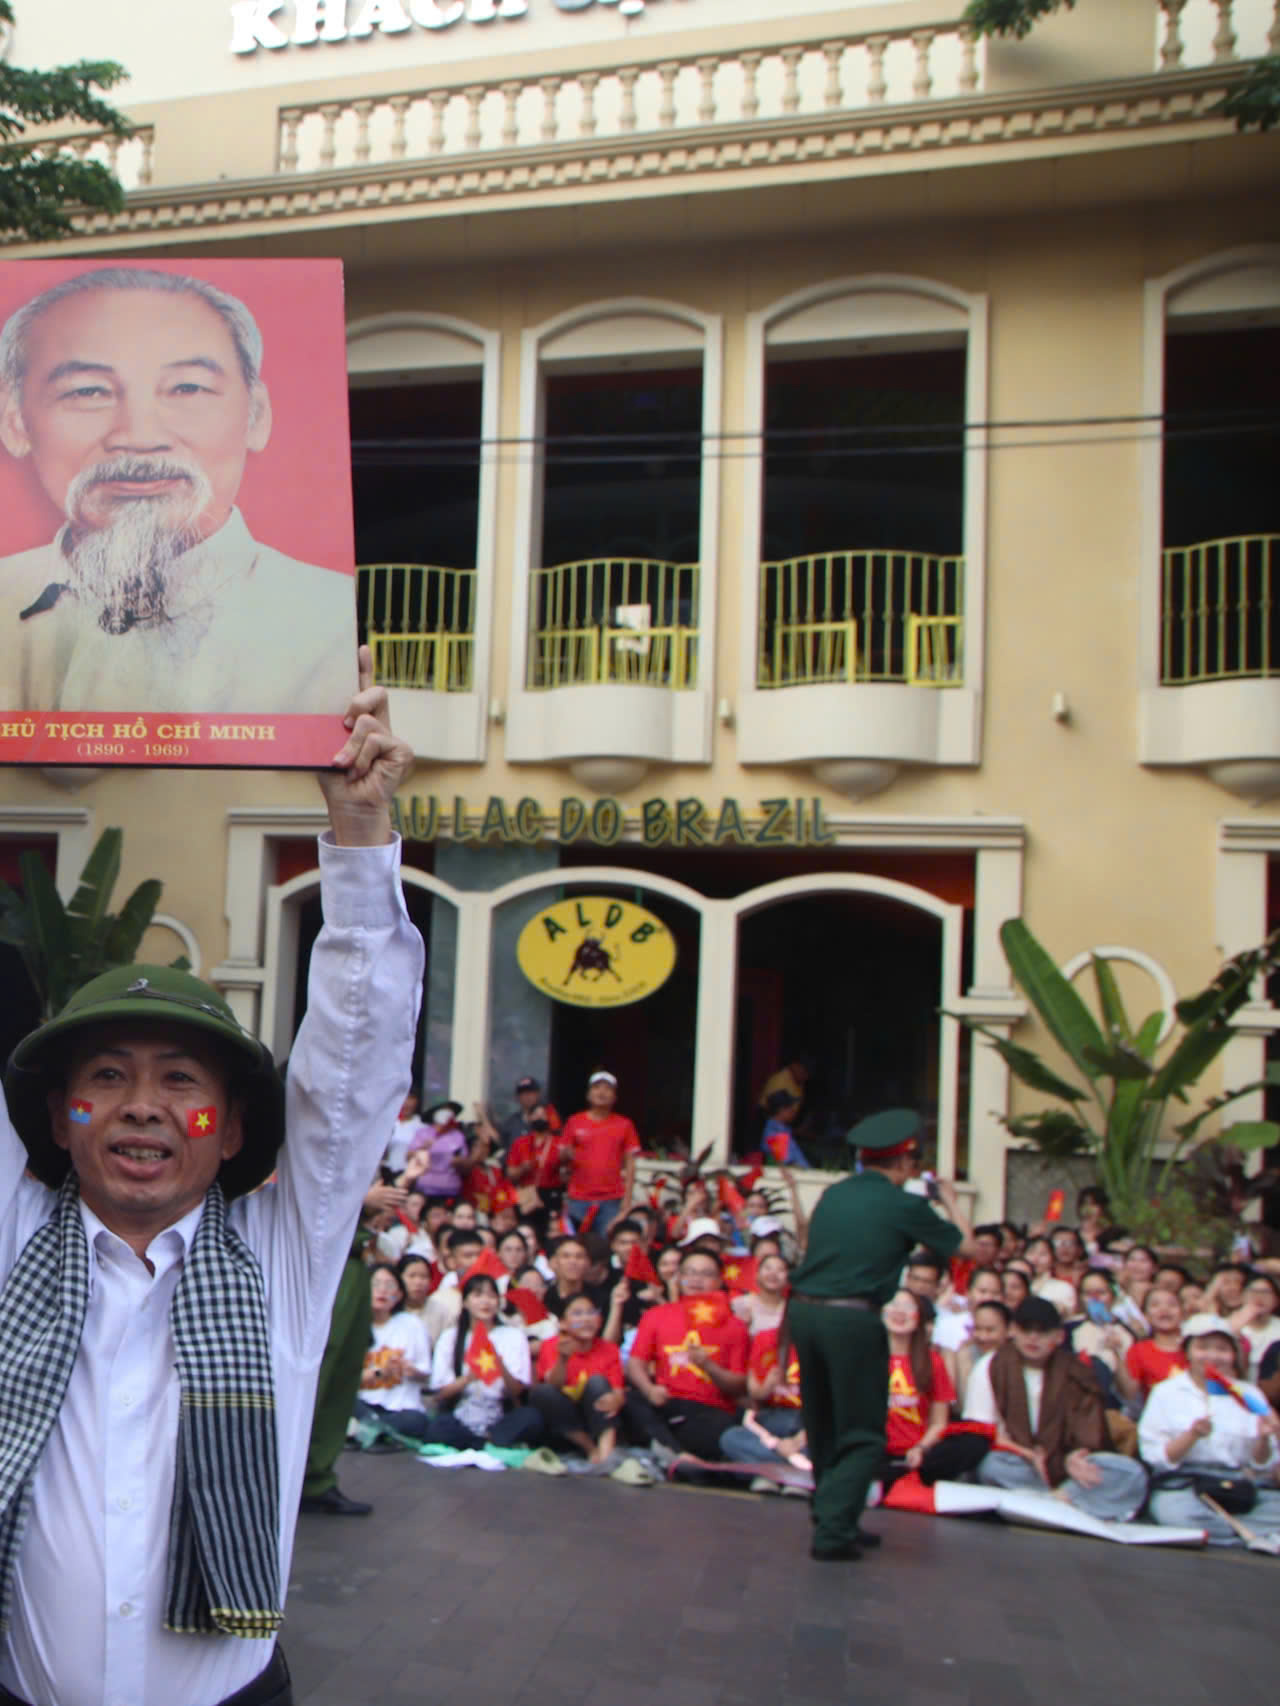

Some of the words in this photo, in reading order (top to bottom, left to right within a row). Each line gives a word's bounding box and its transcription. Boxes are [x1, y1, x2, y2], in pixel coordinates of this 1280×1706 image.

[45, 722, 105, 741] TỊCH
[113, 716, 148, 739] HỒ
[157, 721, 201, 739] CHÍ
[209, 725, 276, 740] MINH
[76, 743, 124, 757] (1890
[144, 743, 190, 757] 1969)
[452, 795, 544, 844] LAC
[558, 796, 621, 846] DO
[640, 796, 838, 848] BRAZIL
[541, 902, 656, 944] ALDB
